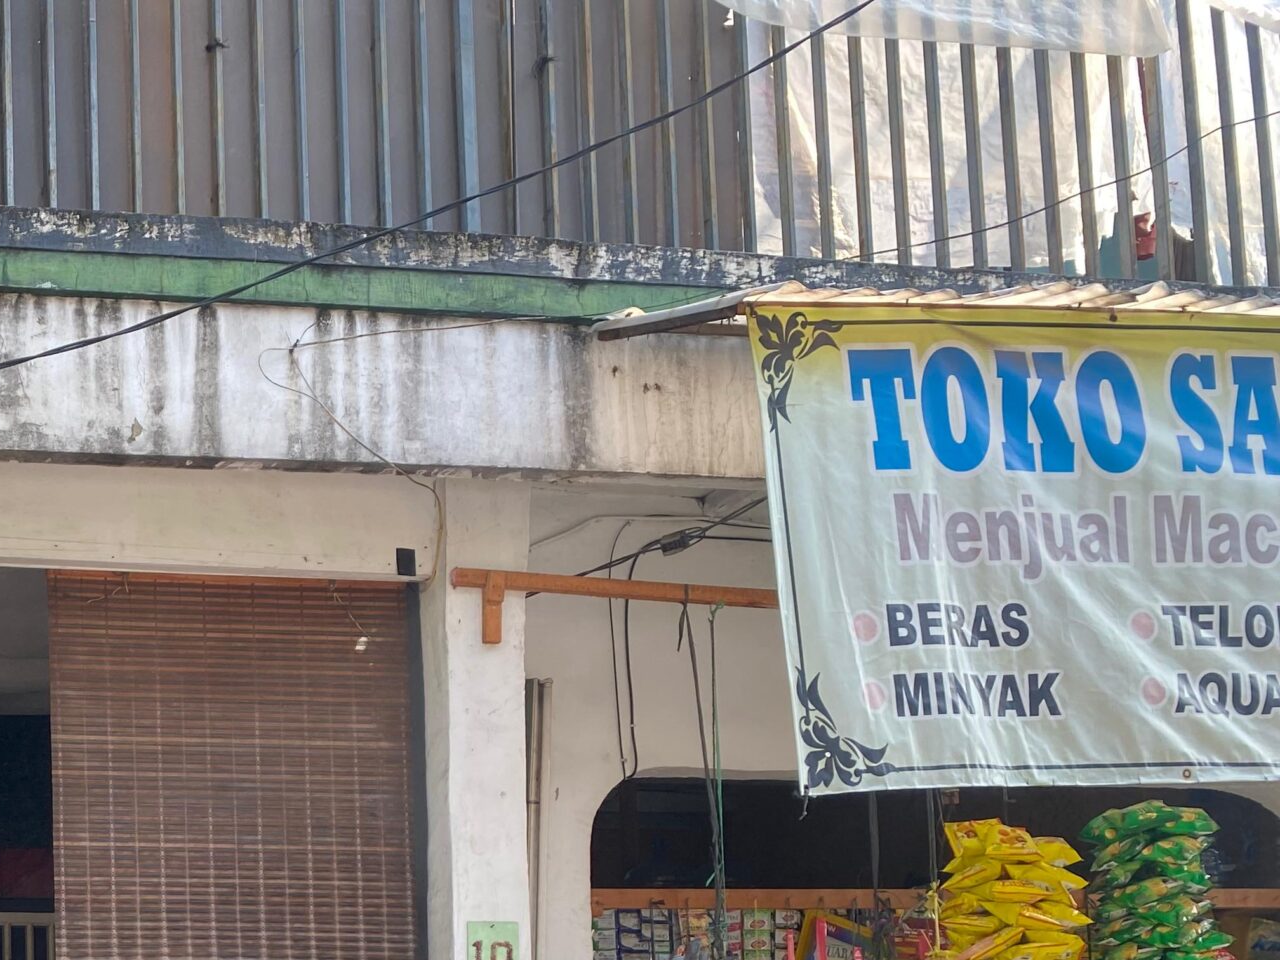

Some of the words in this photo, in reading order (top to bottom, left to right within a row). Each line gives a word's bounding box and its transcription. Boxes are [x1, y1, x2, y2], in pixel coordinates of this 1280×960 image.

[847, 346, 1147, 474] TOKO
[1170, 353, 1280, 475] SA
[892, 492, 1131, 579] Menjual
[885, 603, 1030, 648] BERAS
[1161, 605, 1280, 648] TELO
[892, 671, 1062, 718] MINYAK
[1175, 672, 1280, 716] AQUA
